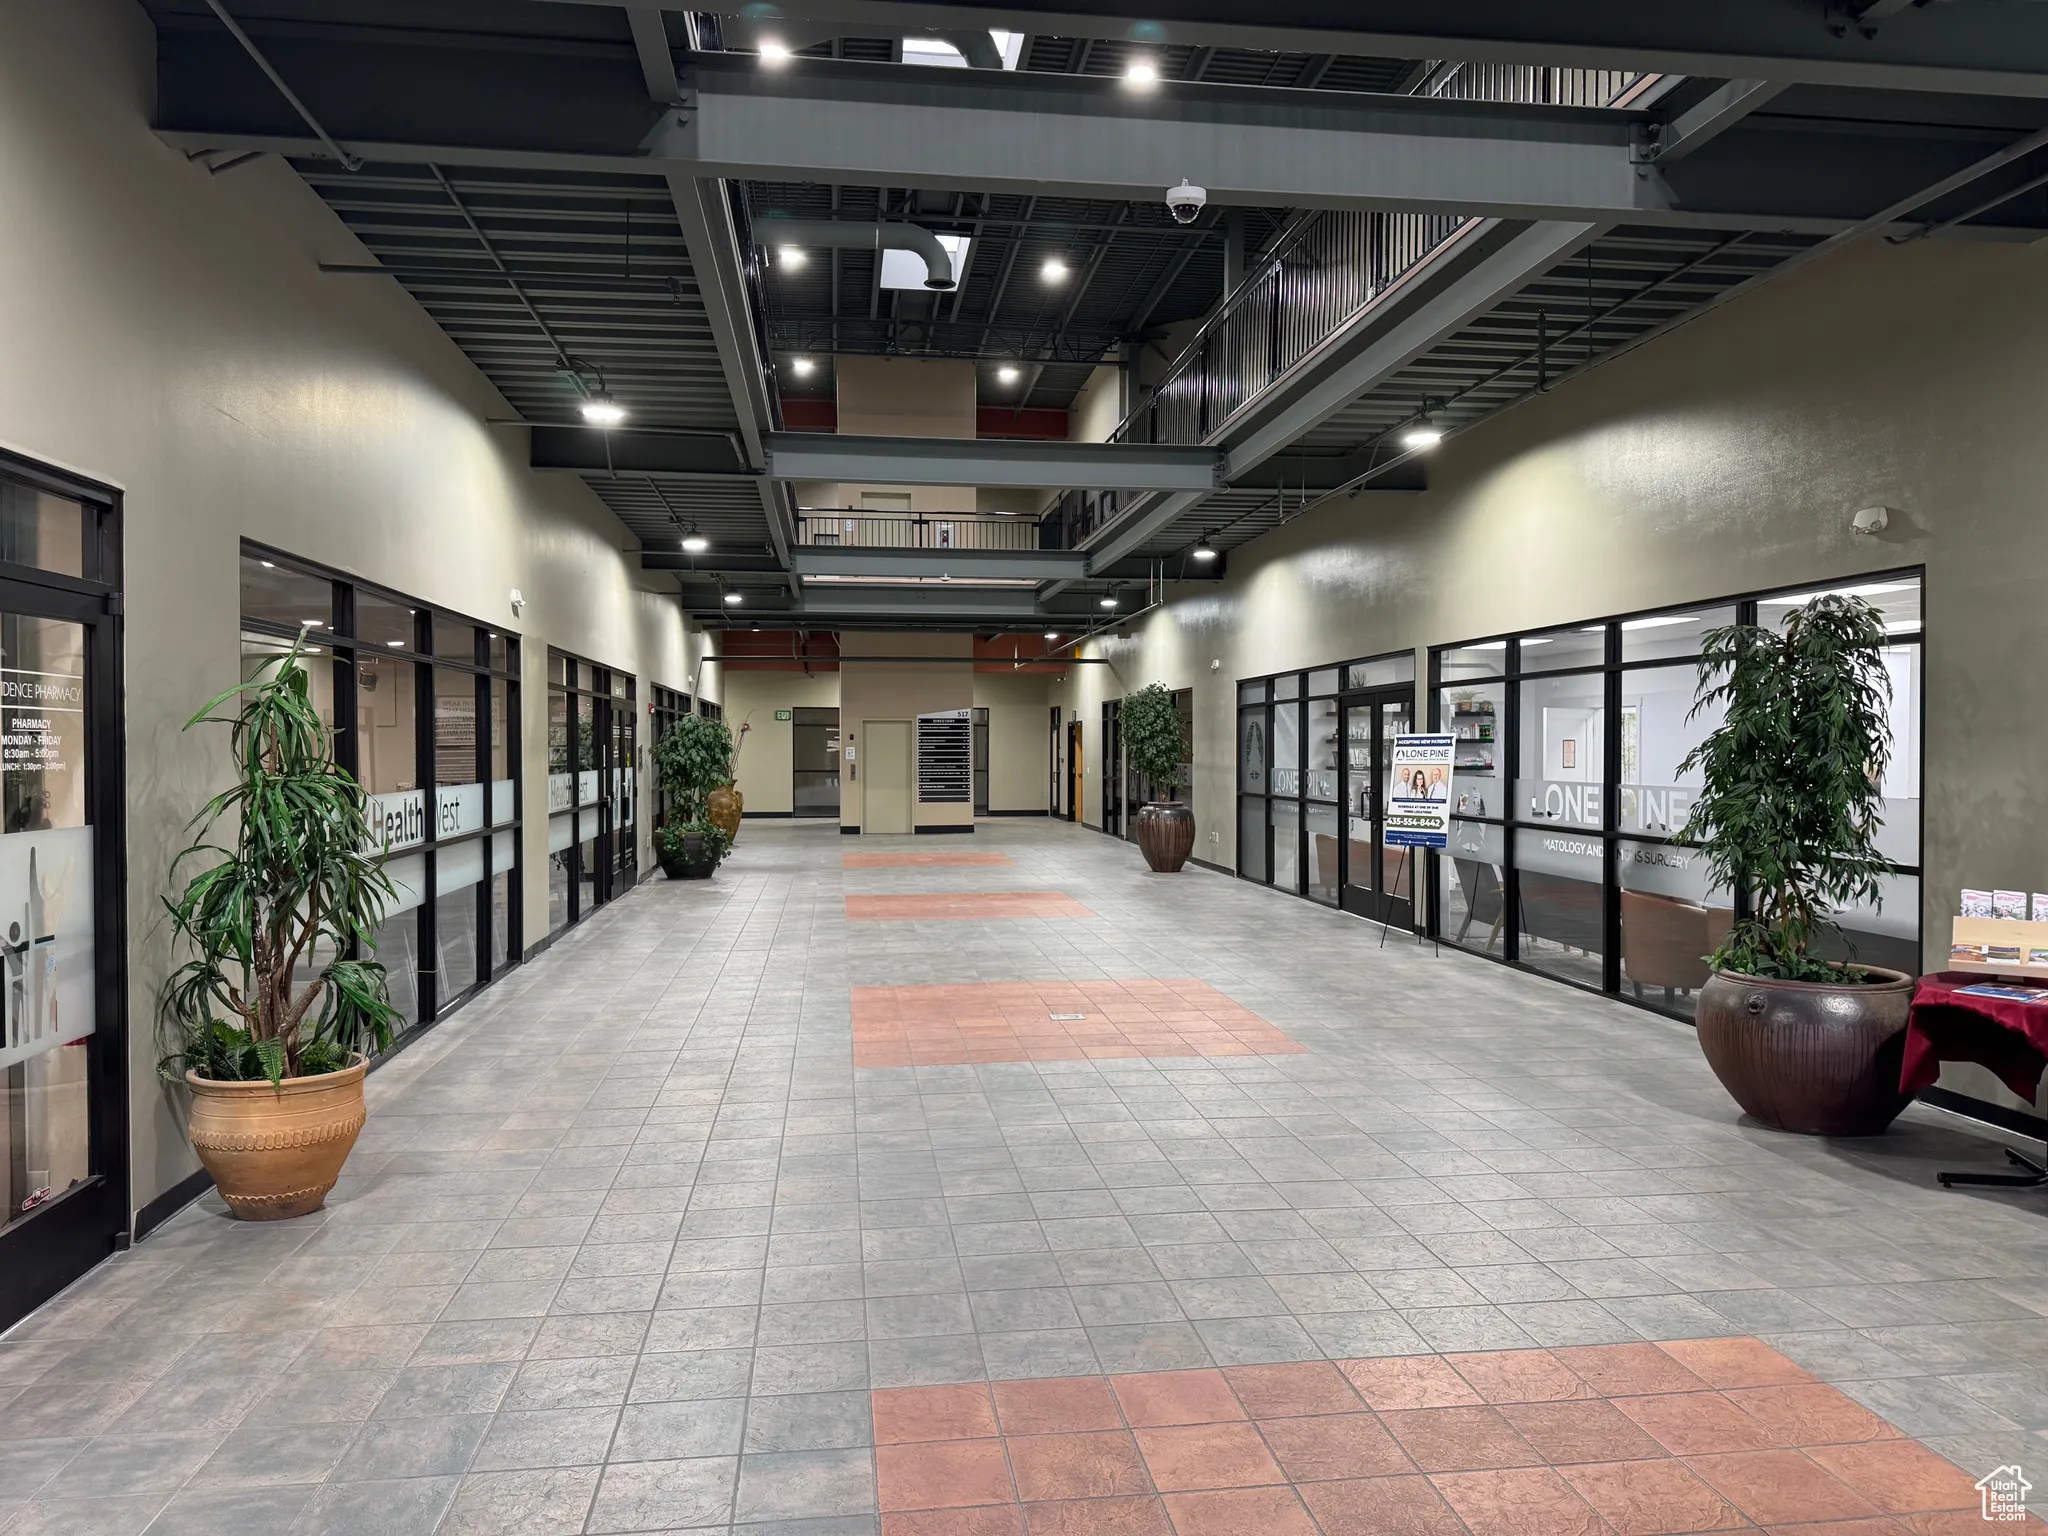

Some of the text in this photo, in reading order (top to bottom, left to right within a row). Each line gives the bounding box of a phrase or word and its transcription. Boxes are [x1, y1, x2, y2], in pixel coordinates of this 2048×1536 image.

[35, 684, 81, 701] PHARMACY
[12, 718, 51, 729] PHARMACY
[1, 735, 32, 745] MONDAY
[38, 736, 62, 745] FRIDAY
[4, 749, 29, 759] 8:30am
[35, 749, 59, 760] 5:00pm
[1405, 749, 1450, 758] LONE PINE
[23, 763, 41, 772] 1:30pm
[1617, 788, 1689, 833] PINE
[373, 796, 423, 848] Health
[1387, 817, 1440, 828] 435-554-8442
[1586, 845, 1604, 858] AND
[1644, 852, 1690, 870] SURGERY
